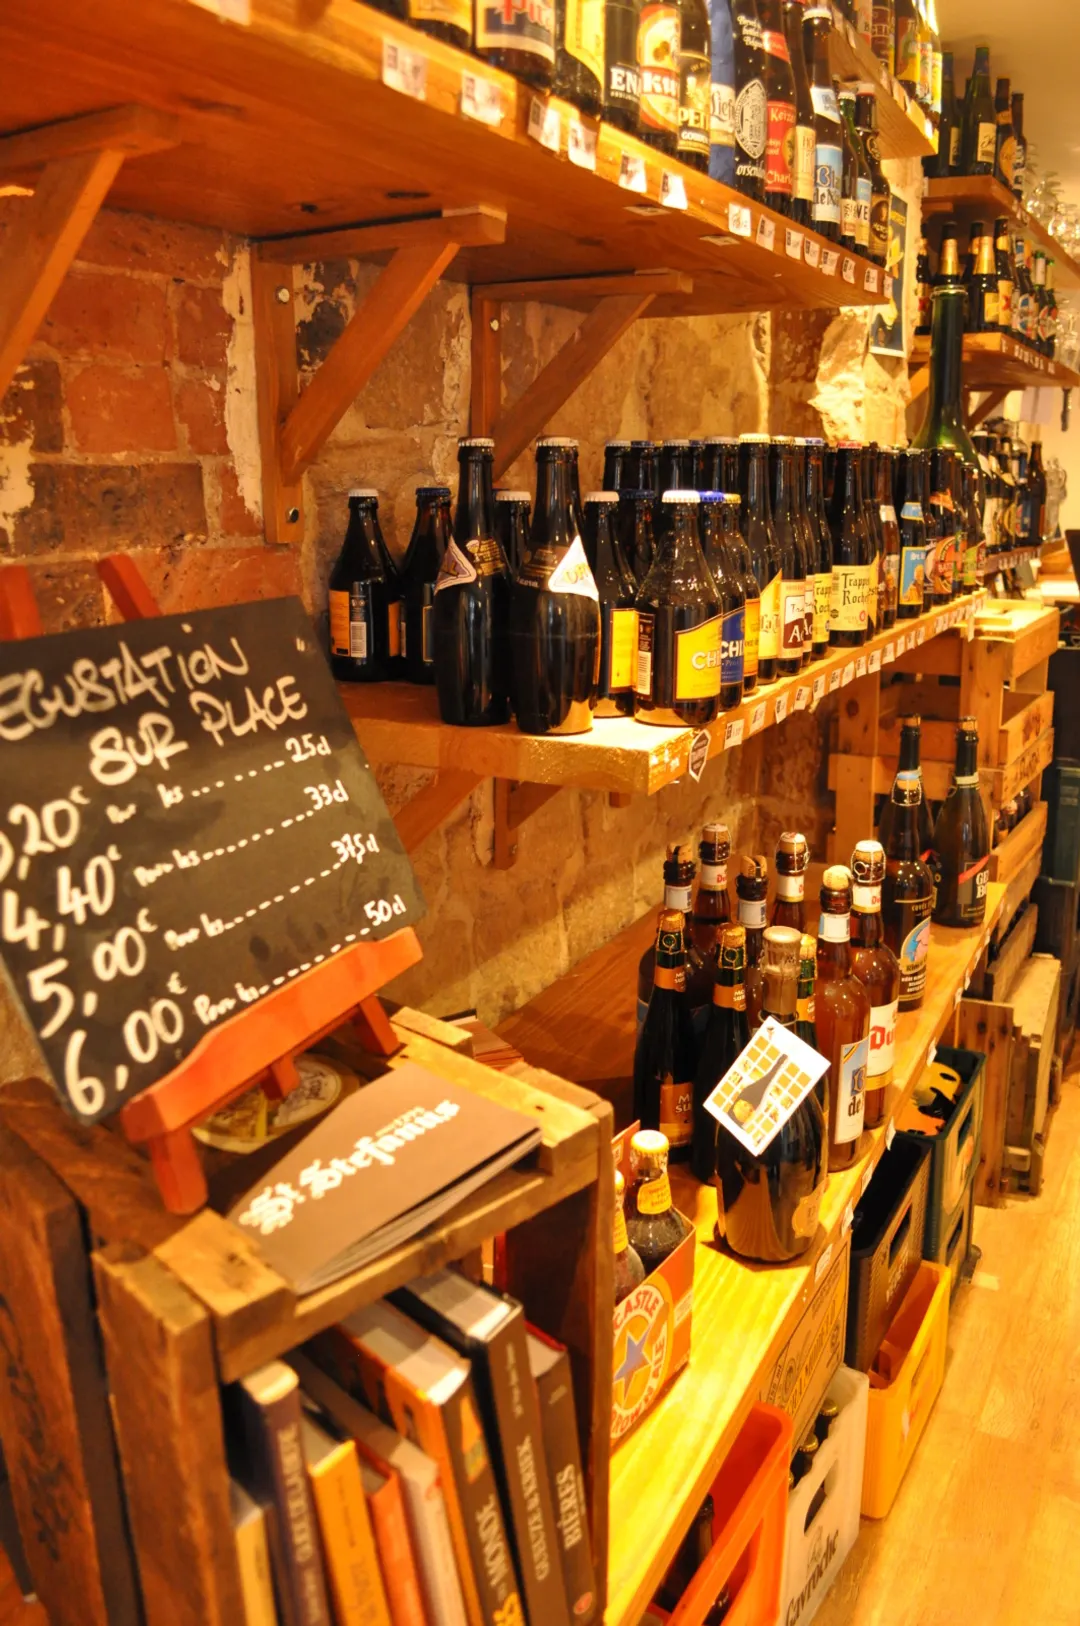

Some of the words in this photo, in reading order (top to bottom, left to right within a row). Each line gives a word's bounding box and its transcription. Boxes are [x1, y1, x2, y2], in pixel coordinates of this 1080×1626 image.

[89, 711, 189, 786] SUR
[190, 676, 308, 747] PLACE
[299, 1100, 460, 1199] Stefanus
